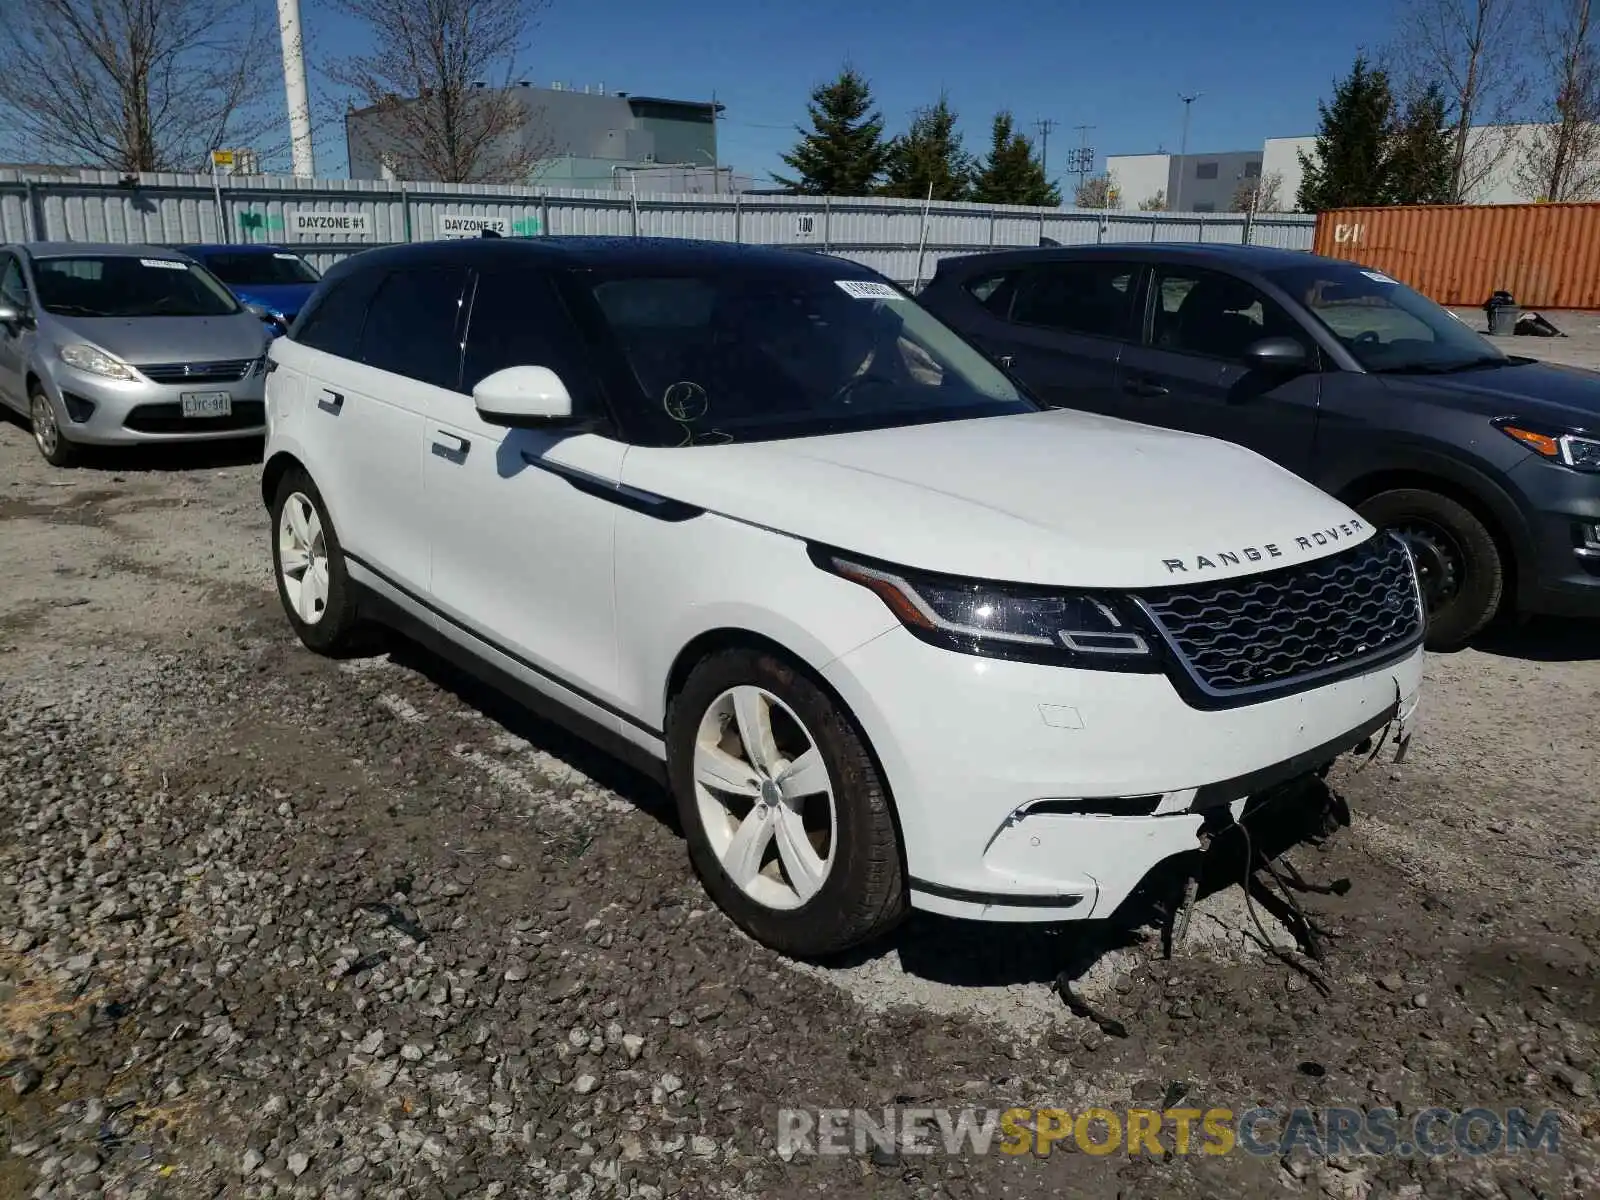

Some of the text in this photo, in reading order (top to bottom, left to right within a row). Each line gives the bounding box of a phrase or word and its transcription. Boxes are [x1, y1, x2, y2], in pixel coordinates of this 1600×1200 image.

[298, 216, 365, 229] DAYZONE #1
[444, 219, 489, 231] DAYZONE
[798, 217, 813, 232] 100
[1162, 519, 1363, 573] RANGE ROVER
